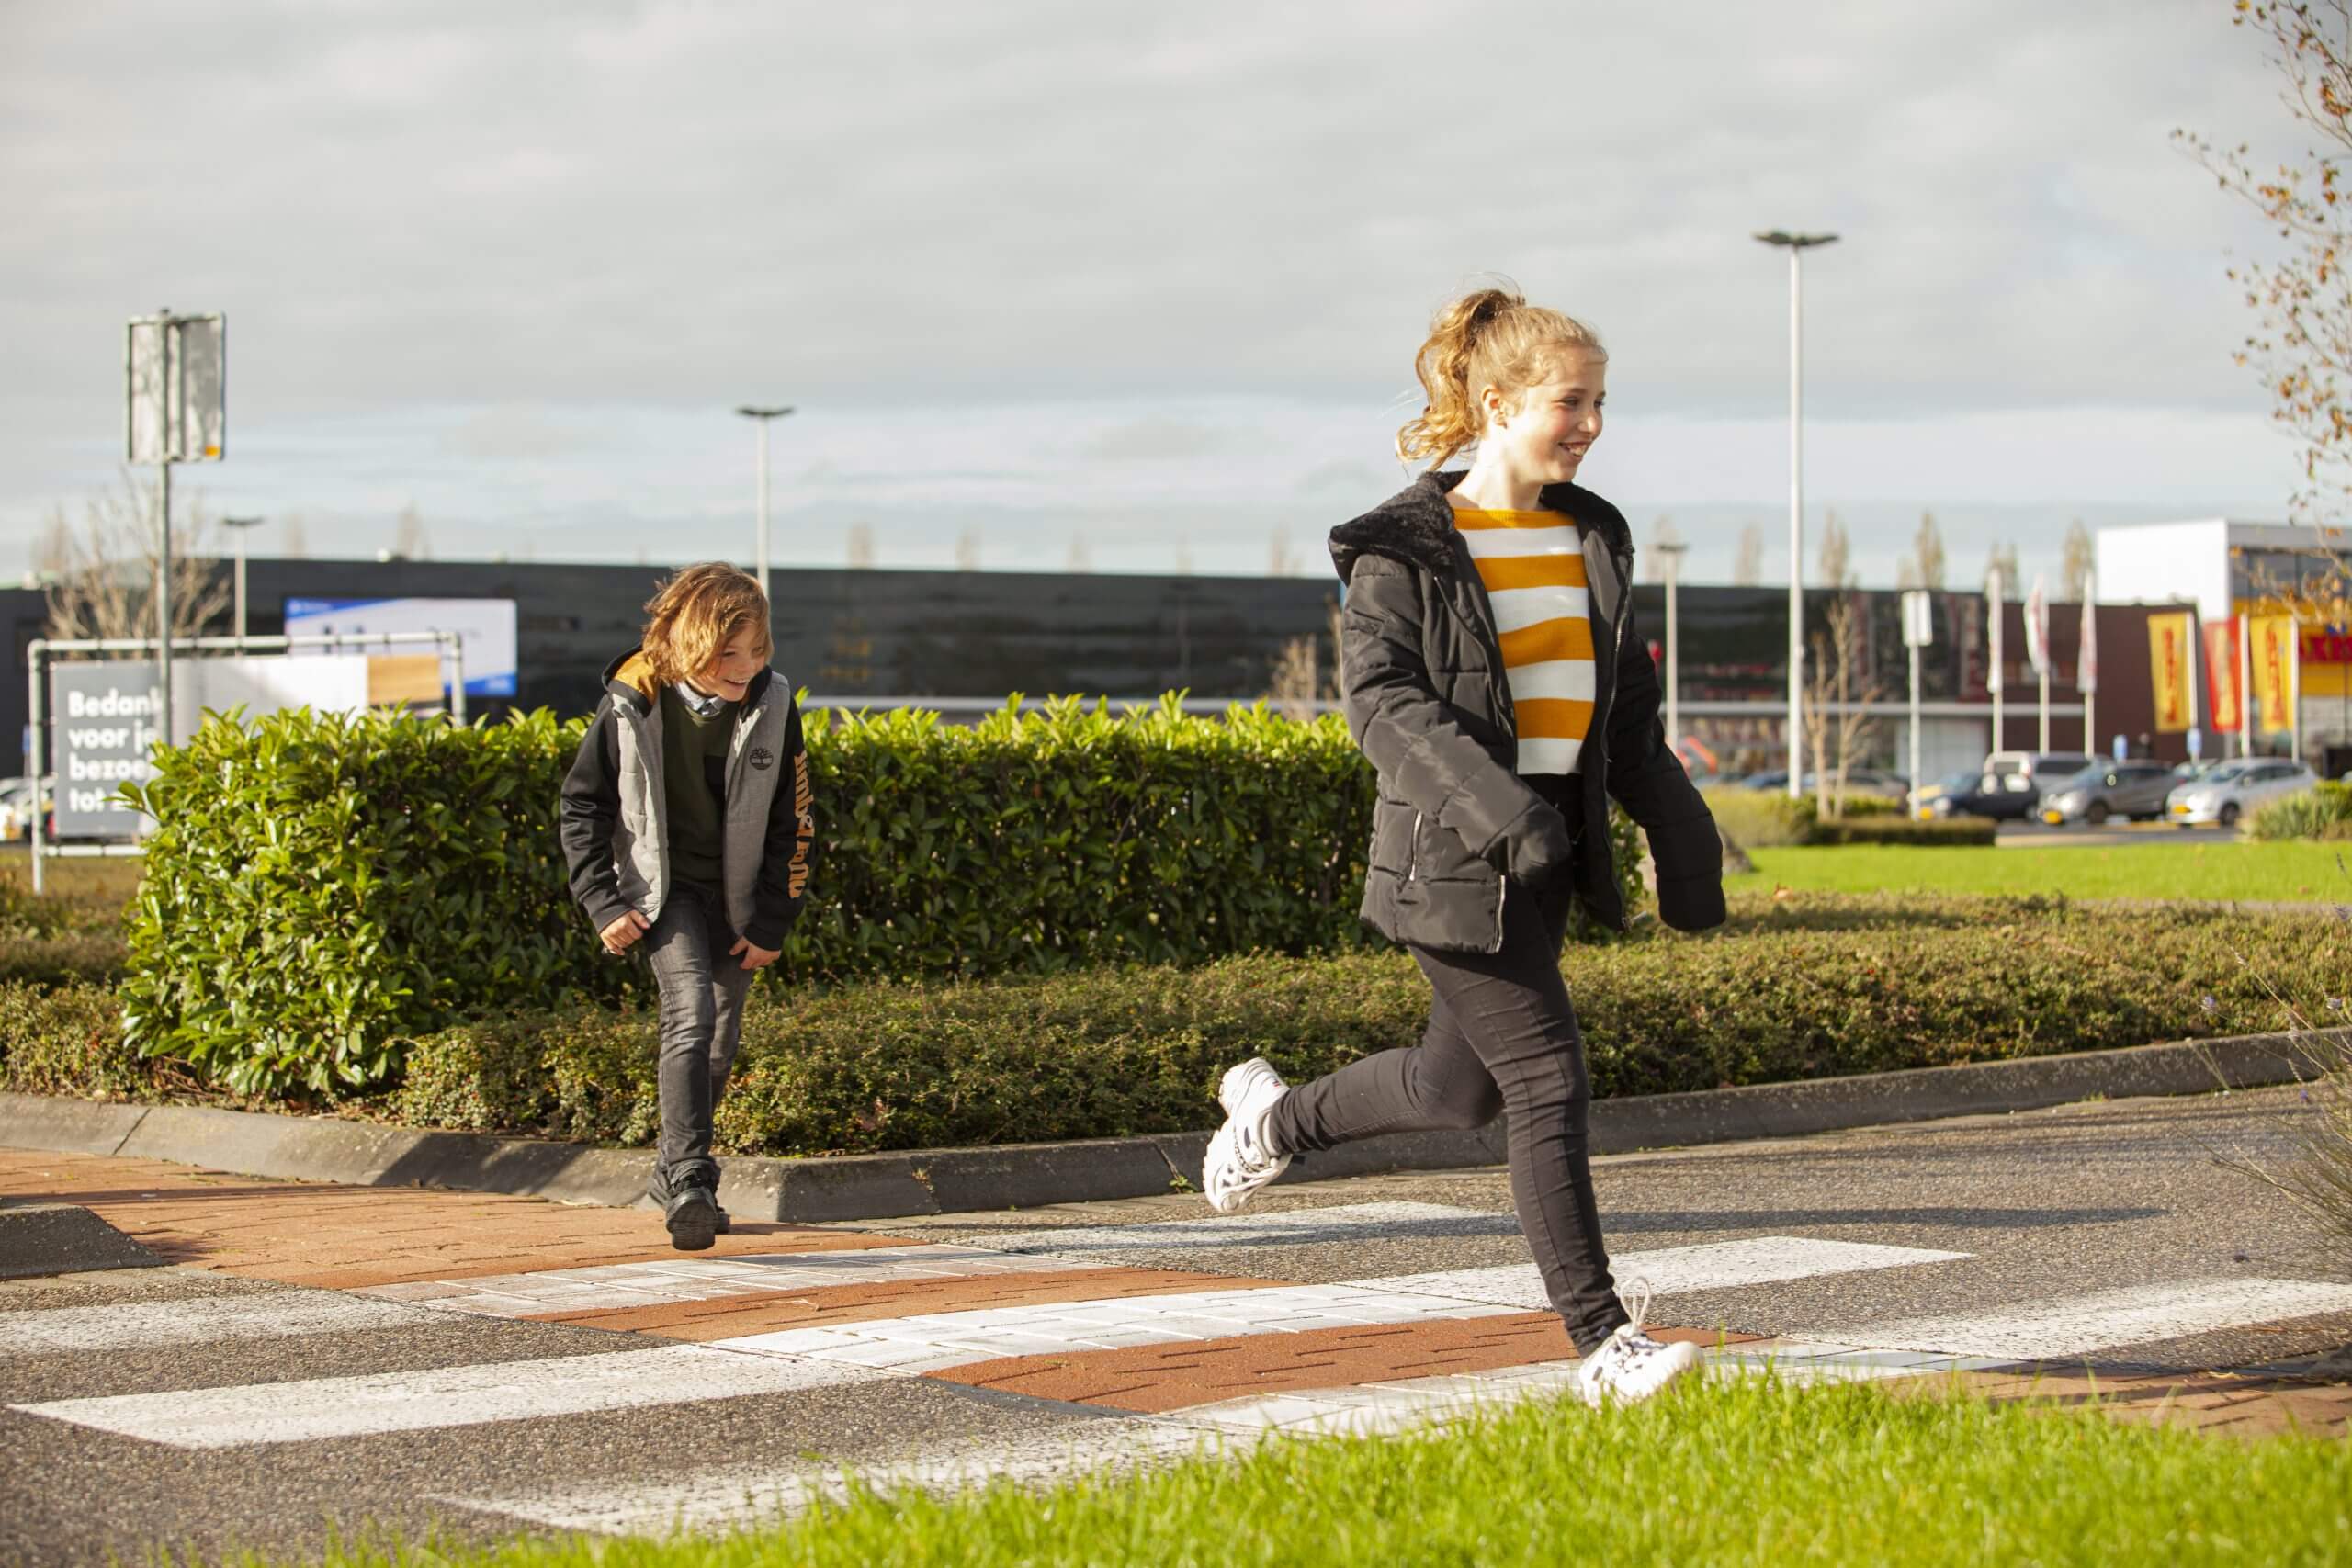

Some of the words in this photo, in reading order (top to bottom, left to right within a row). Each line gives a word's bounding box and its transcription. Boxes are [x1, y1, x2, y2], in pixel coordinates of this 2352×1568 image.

[68, 728, 129, 749] voor
[69, 751, 153, 781] bezoe
[69, 787, 105, 812] tot
